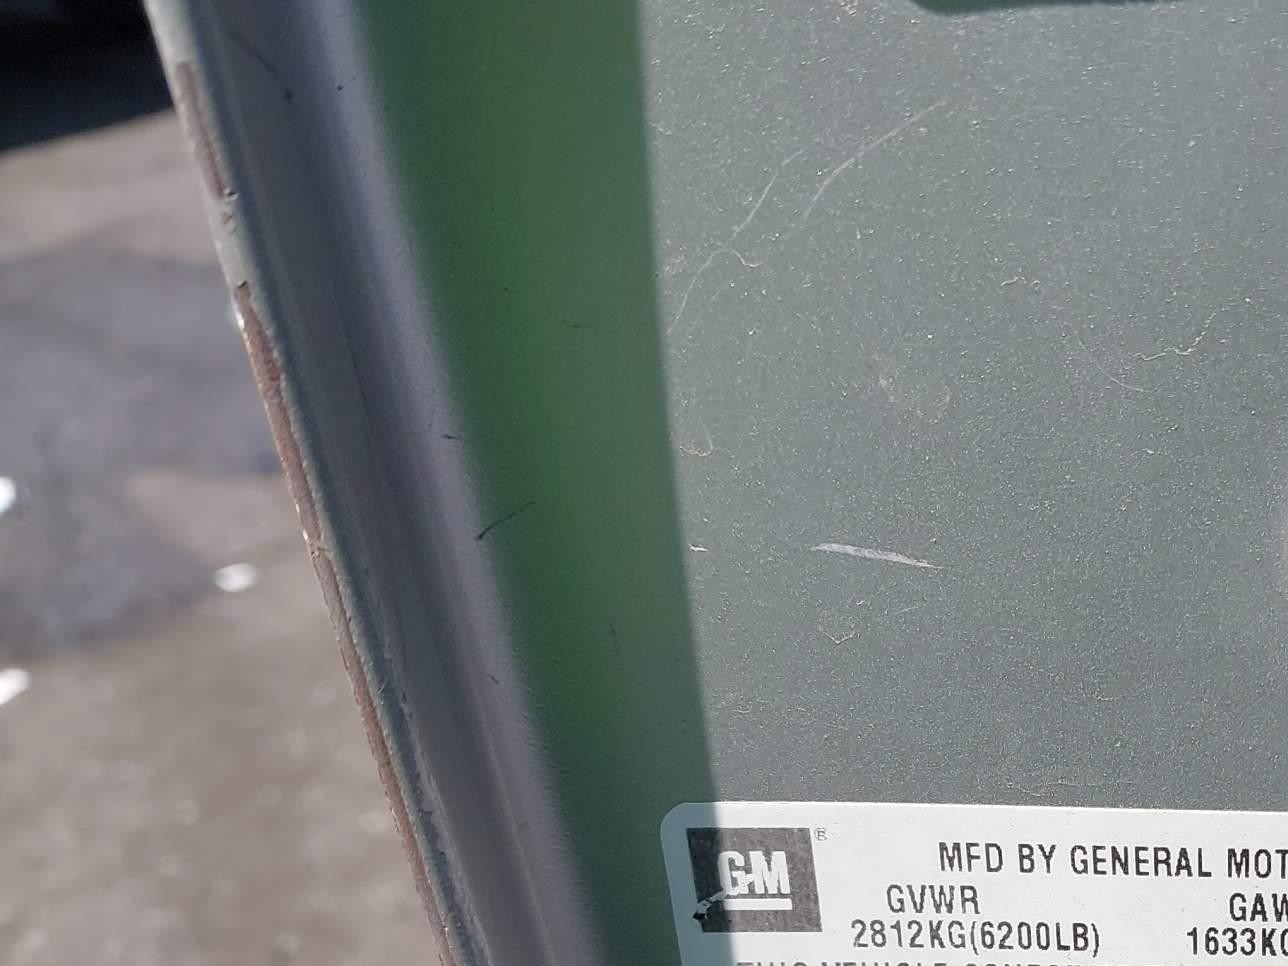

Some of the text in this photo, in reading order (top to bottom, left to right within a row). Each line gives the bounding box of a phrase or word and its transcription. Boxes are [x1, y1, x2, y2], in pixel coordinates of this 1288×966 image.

[717, 850, 791, 895] GM
[939, 842, 1004, 873] MFD
[1019, 844, 1056, 874] BY
[1071, 845, 1212, 877] GENERAL
[887, 885, 979, 913] GVWR
[852, 920, 1099, 955] 2812KG(6200LB)
